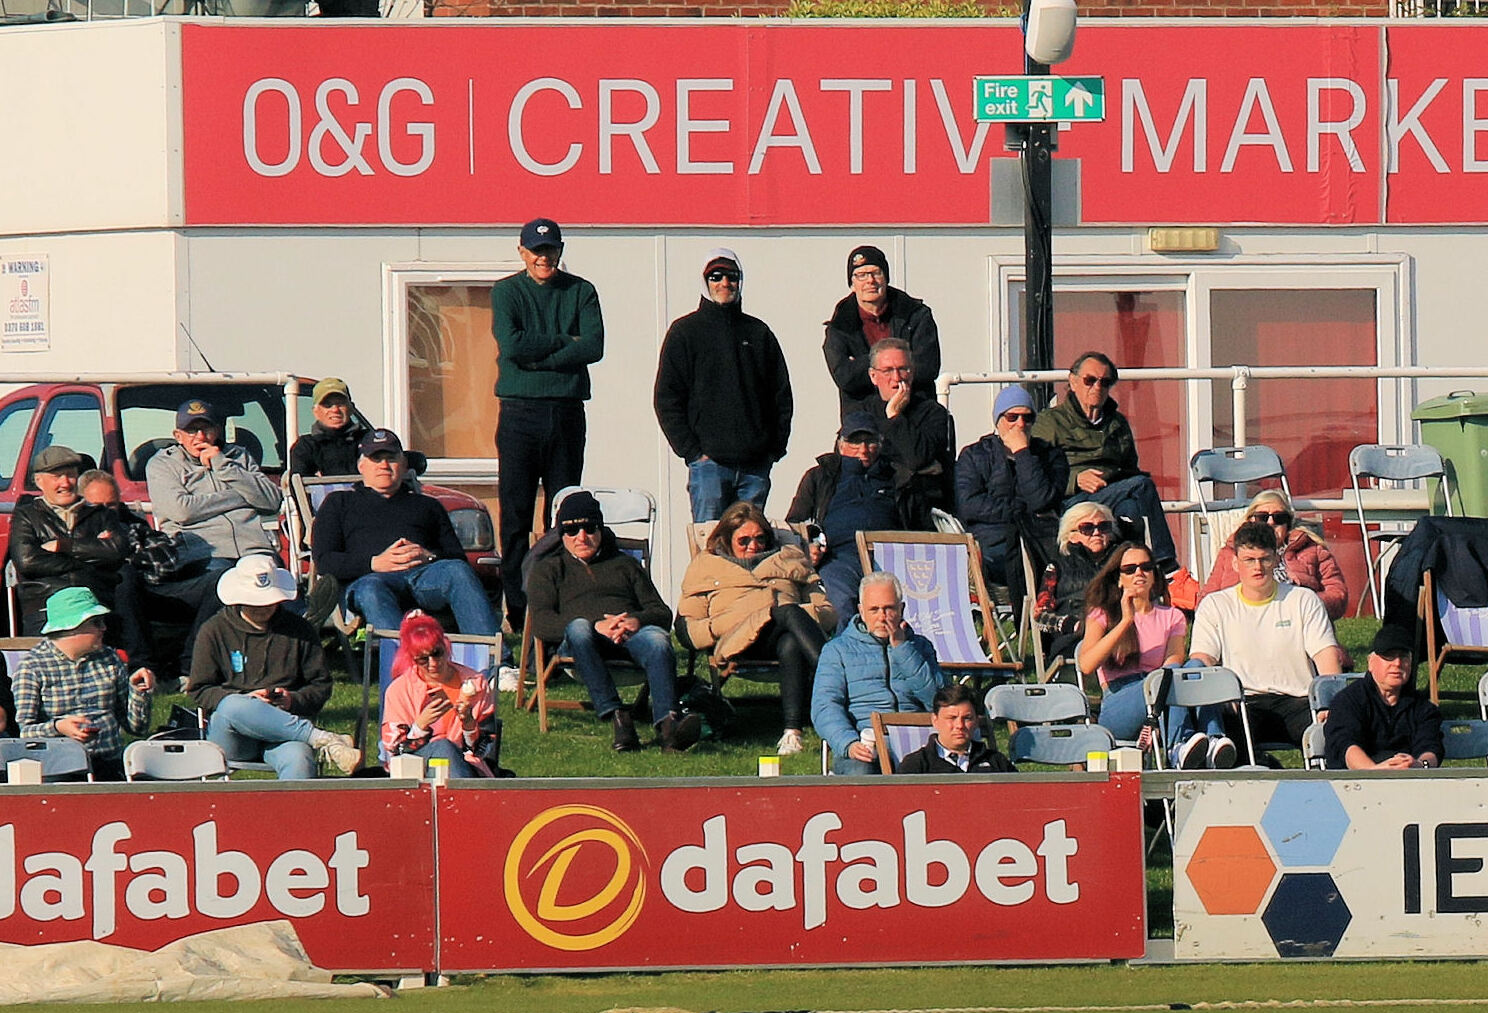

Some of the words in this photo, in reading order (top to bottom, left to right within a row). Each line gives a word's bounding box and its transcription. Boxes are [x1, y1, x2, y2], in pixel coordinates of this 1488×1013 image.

[984, 82, 1019, 98] Fire
[985, 101, 1018, 115] exit
[243, 77, 435, 177] O&G
[508, 76, 1071, 176] CREATIV
[8, 261, 39, 273] WARNING
[0, 820, 371, 940] afabet
[660, 809, 1080, 931] dafabet
